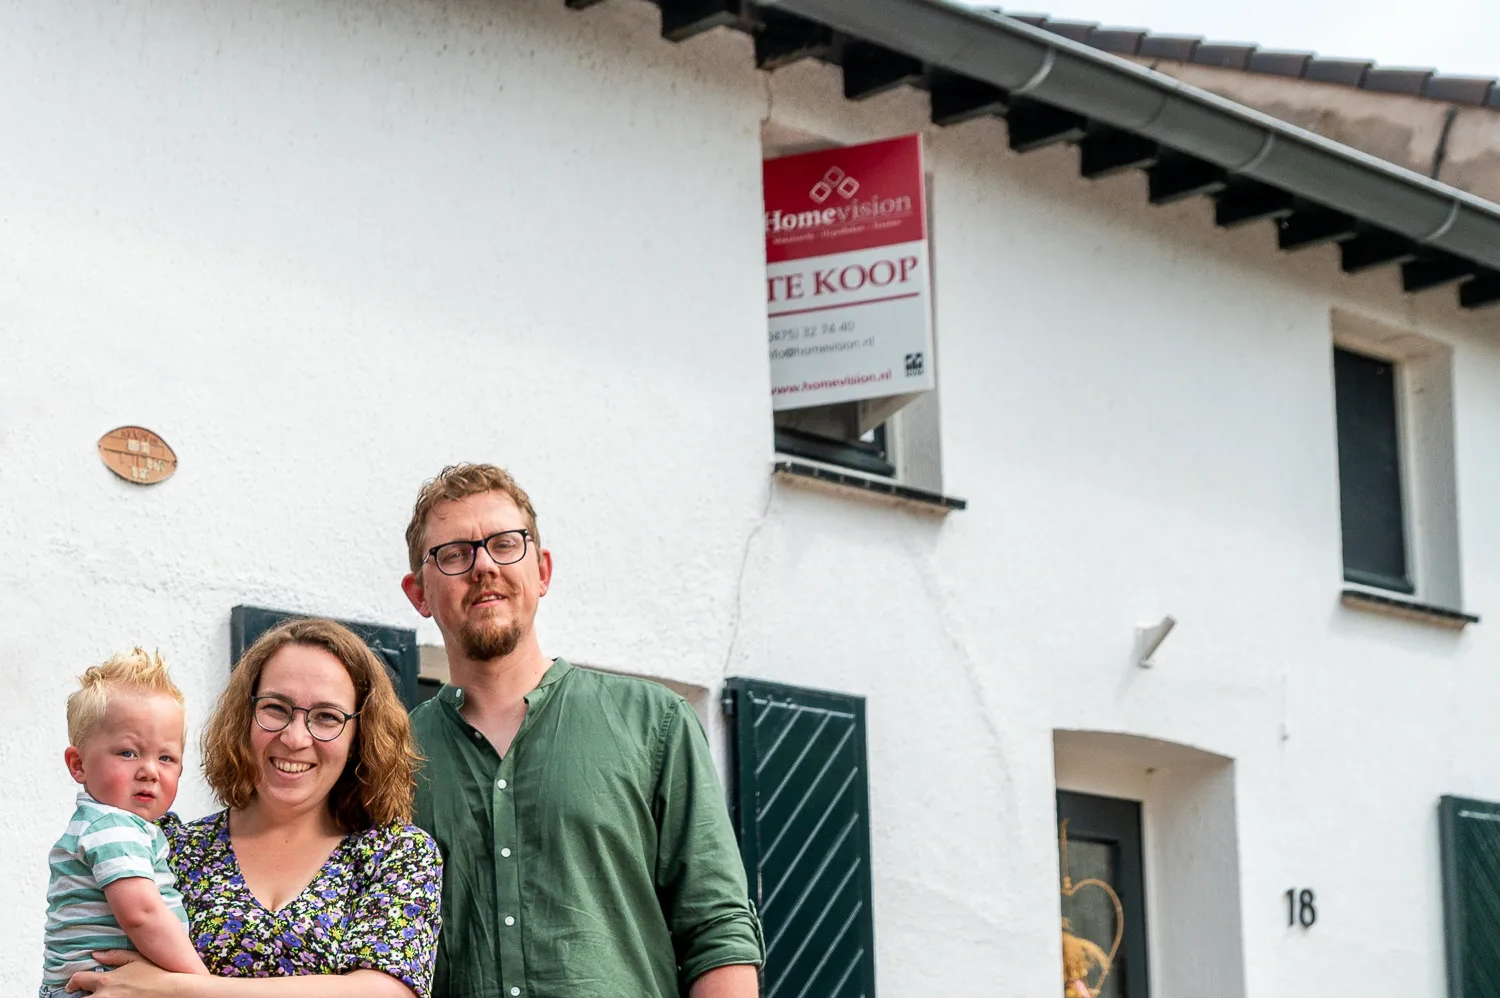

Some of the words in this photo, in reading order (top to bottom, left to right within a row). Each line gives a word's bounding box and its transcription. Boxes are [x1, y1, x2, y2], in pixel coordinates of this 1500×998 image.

[765, 194, 912, 233] Homevision
[767, 272, 805, 304] TE
[813, 255, 919, 297] KOOP
[1284, 888, 1316, 928] 18
